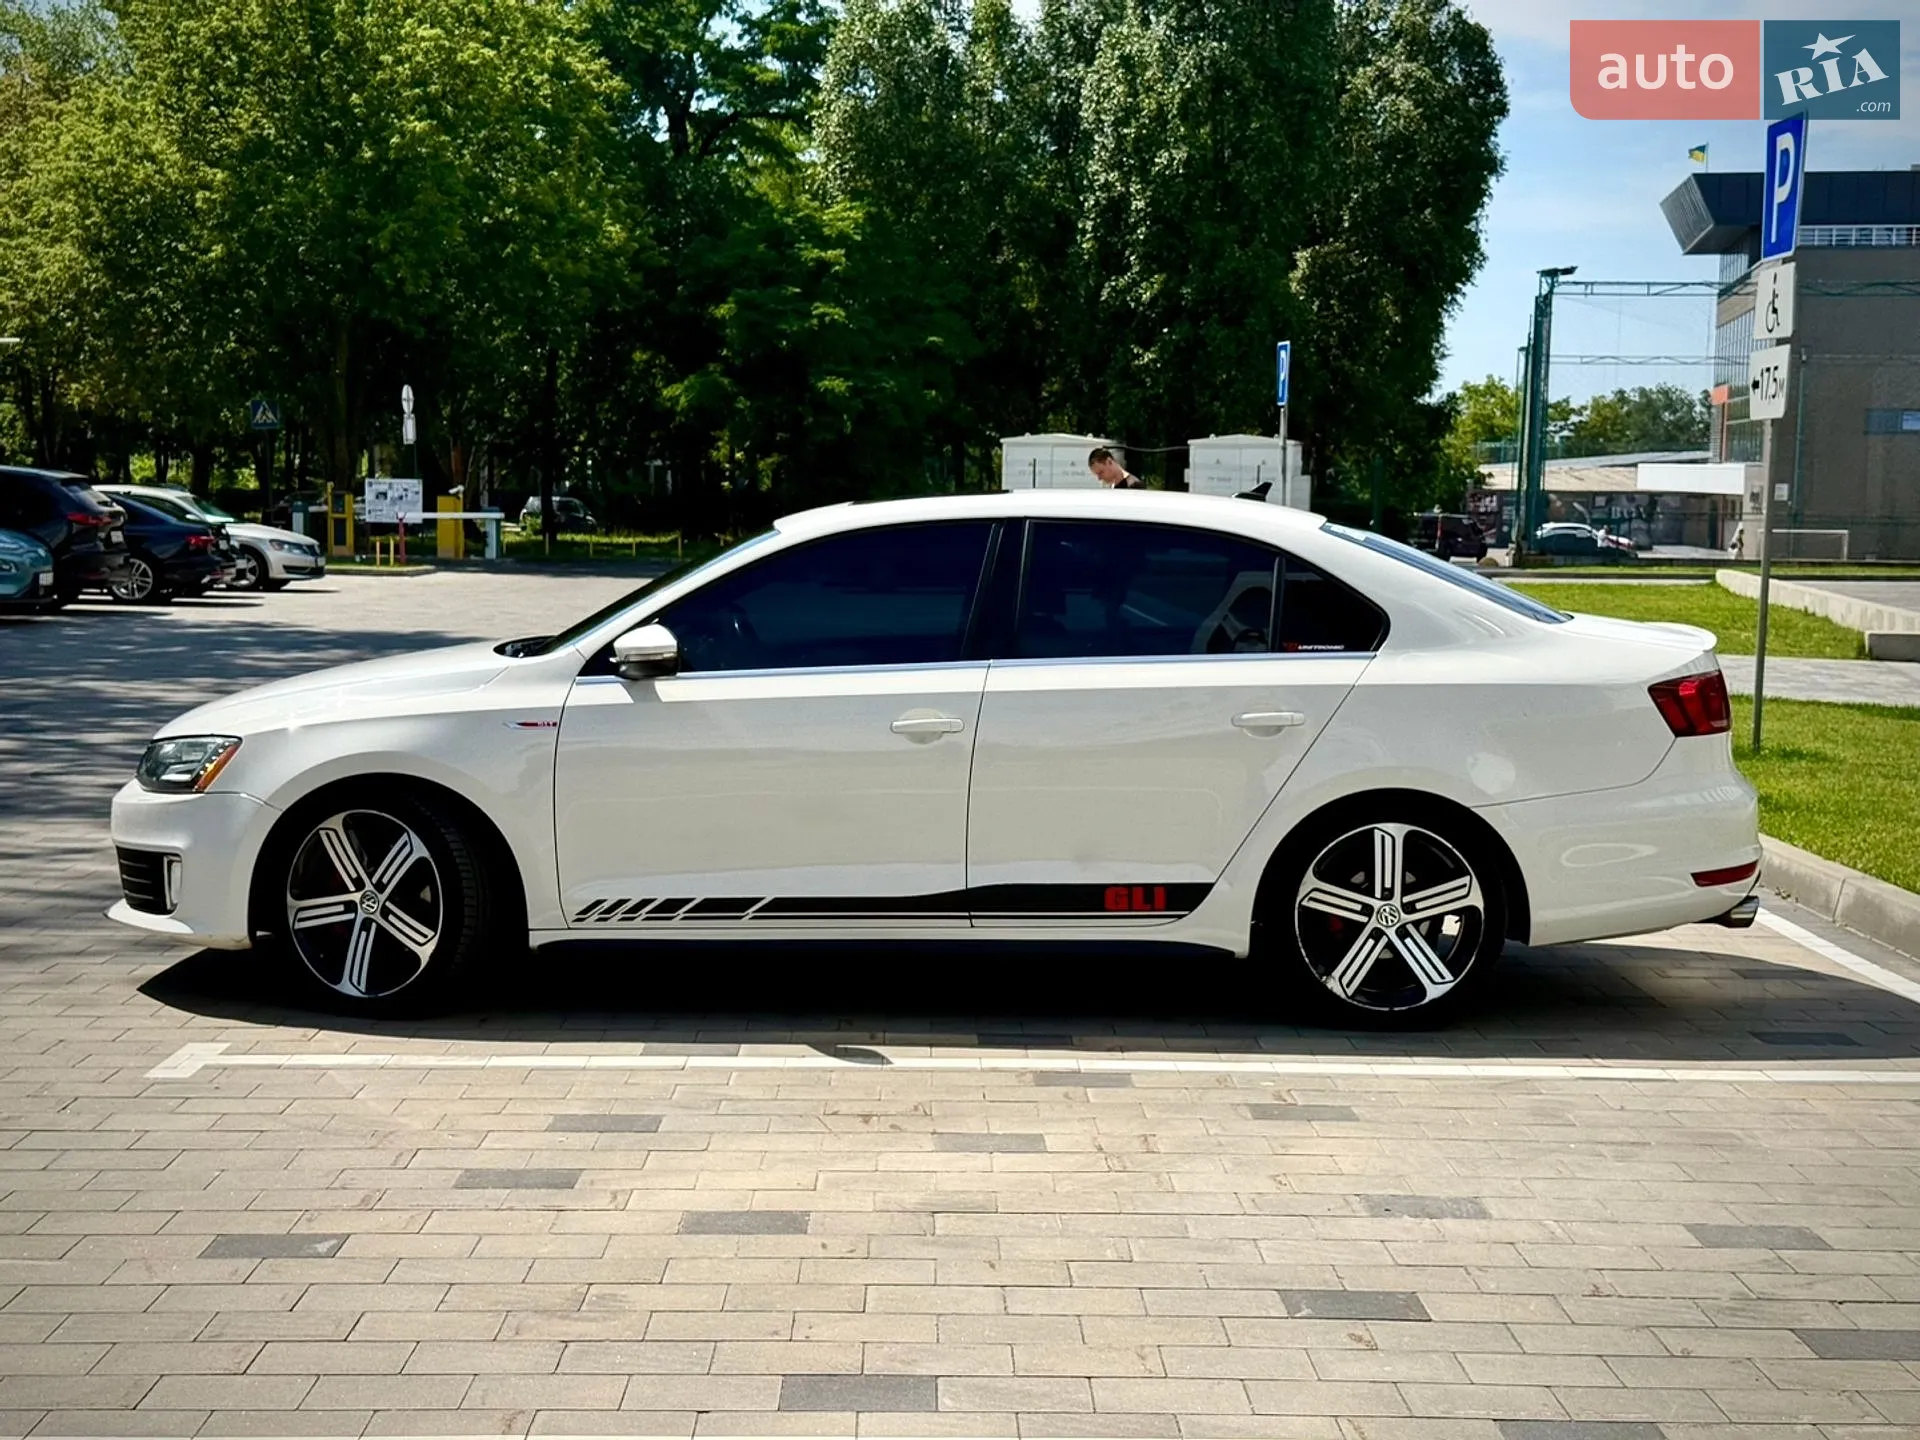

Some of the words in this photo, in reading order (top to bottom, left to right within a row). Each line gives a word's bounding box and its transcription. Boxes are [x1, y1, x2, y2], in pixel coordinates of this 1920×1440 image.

[1771, 132, 1795, 243] P
[1279, 350, 1287, 398] P
[1104, 886, 1166, 911] GLI
